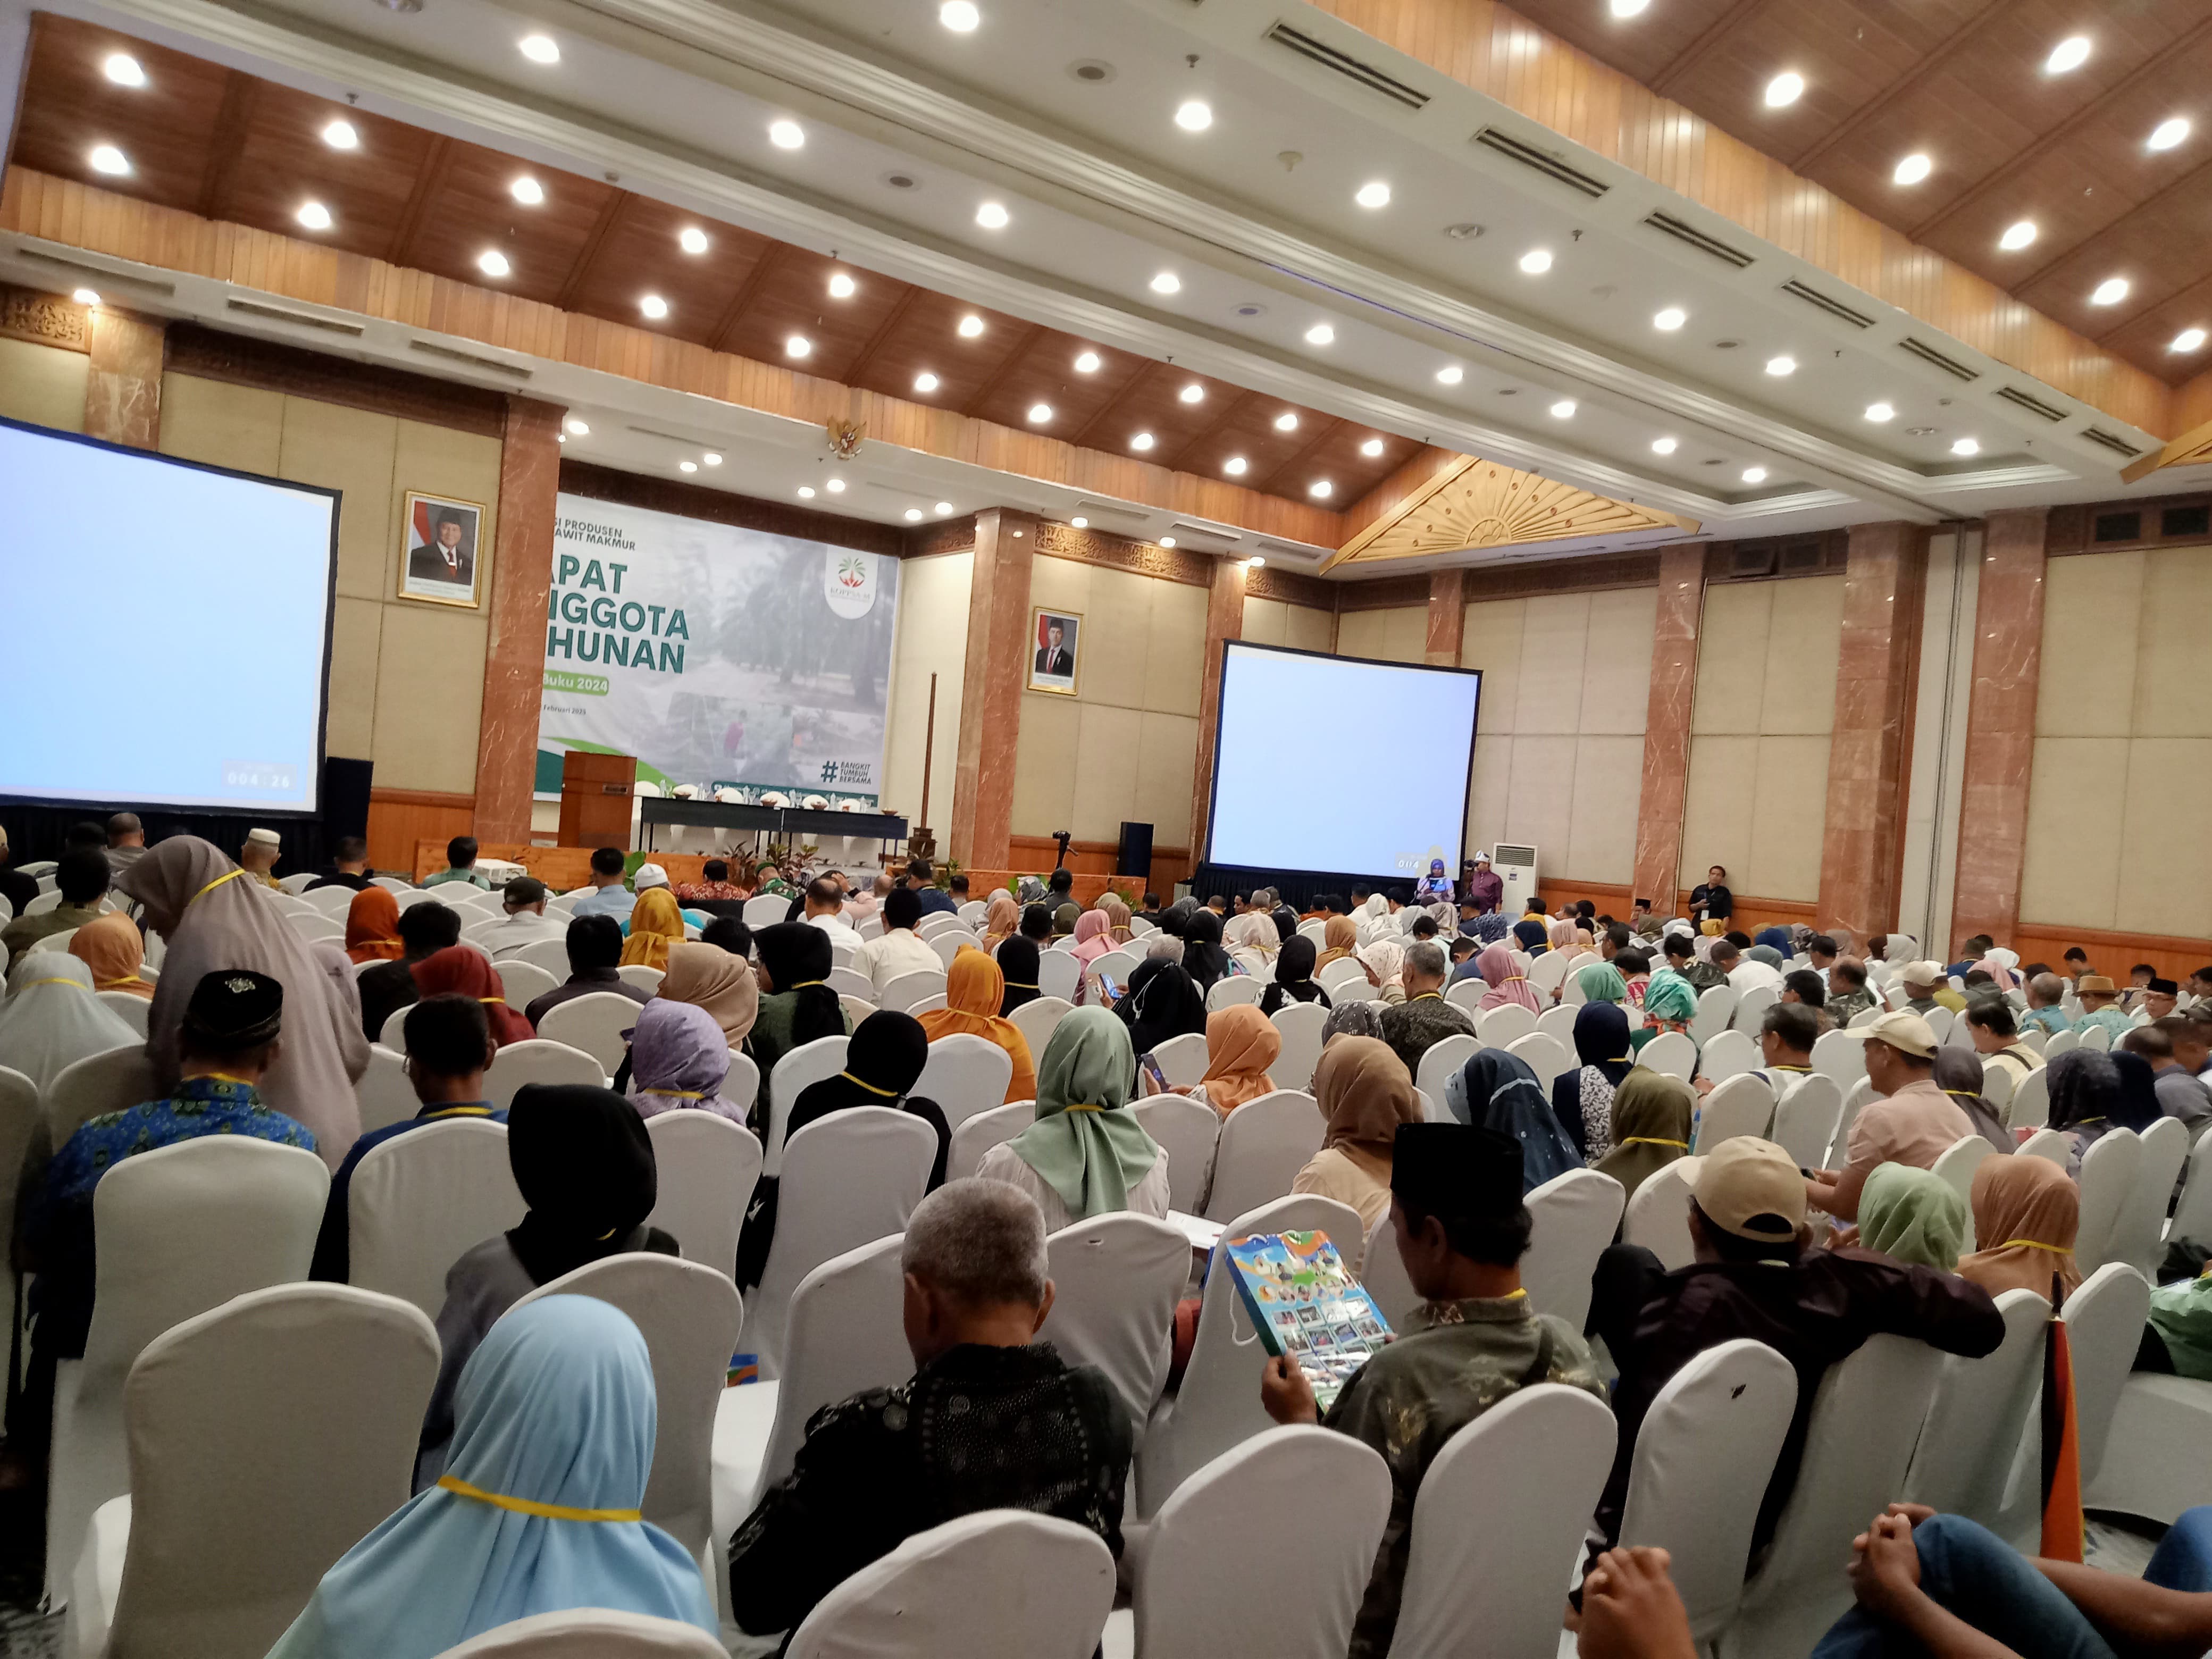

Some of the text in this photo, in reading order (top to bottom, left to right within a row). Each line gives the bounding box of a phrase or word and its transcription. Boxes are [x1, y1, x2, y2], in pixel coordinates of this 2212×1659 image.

[565, 519, 622, 538] PRODUSEN
[586, 534, 636, 551] MAKMUR
[551, 554, 627, 594] PAT
[577, 677, 607, 692] 2024
[543, 704, 571, 714] Februari
[840, 761, 870, 770] BANGKIT
[840, 769, 868, 777] TUMBUH
[839, 776, 872, 785] BERSAMA
